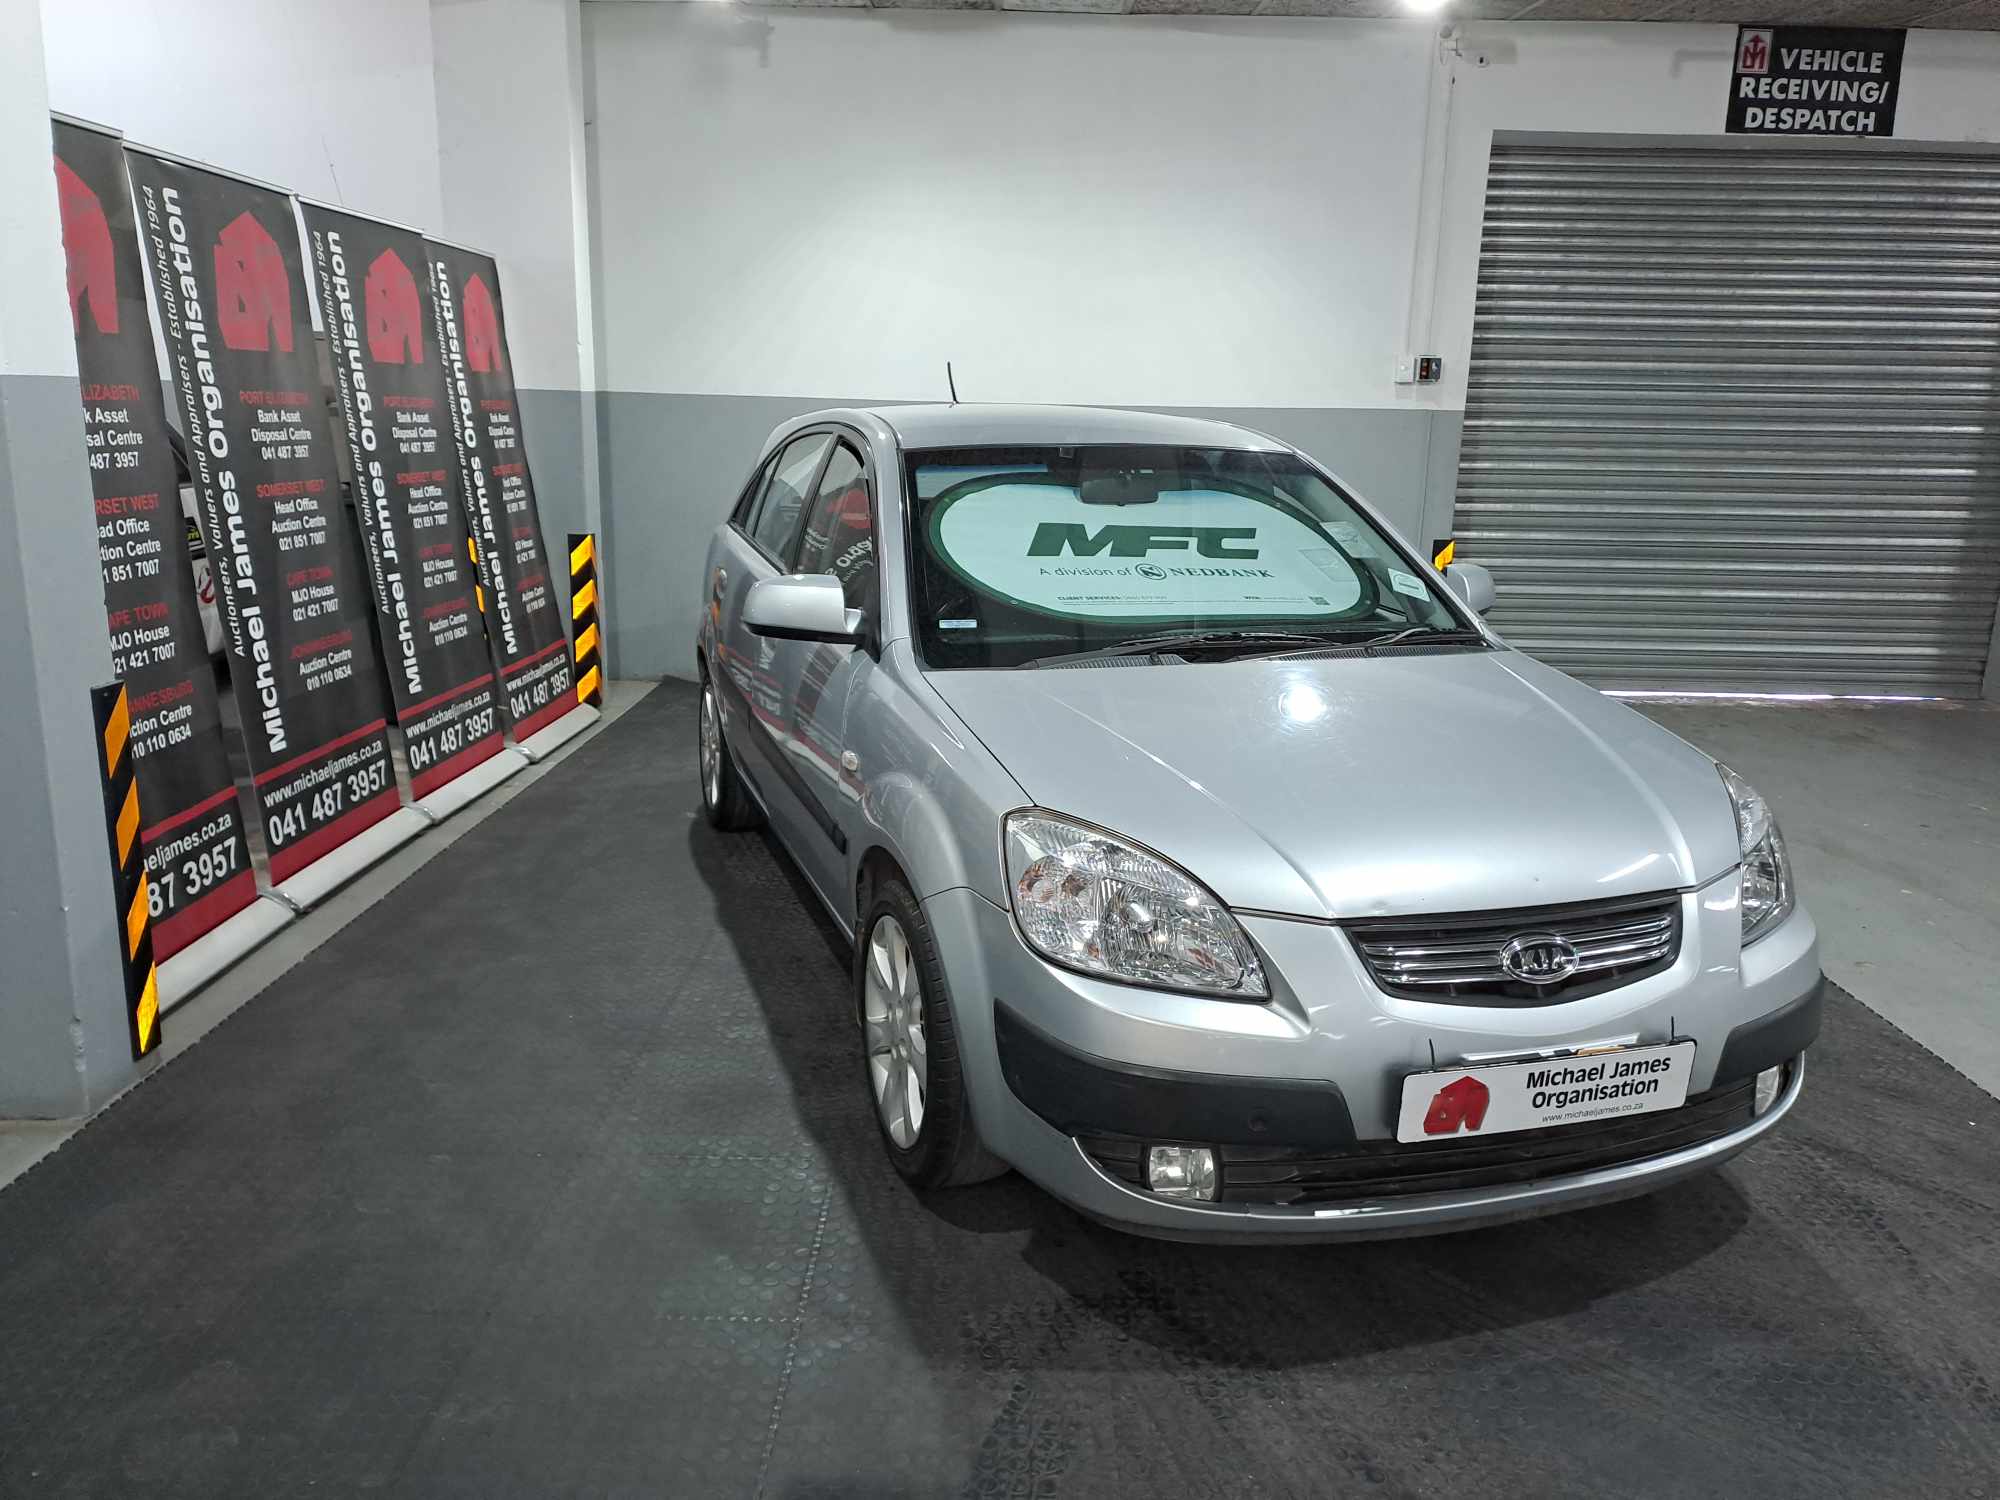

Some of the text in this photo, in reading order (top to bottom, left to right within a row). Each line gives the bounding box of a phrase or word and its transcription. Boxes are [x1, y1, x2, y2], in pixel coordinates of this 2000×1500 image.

[1780, 48, 1884, 73] VEHICLE
[1739, 77, 1890, 104] RECEIVING/
[1744, 107, 1876, 132] DESPATCH
[142, 184, 162, 231] 1964
[152, 233, 183, 339] Established
[82, 384, 139, 401] LIZABETH
[178, 355, 206, 447] Appraisers
[95, 407, 129, 423] Asset
[257, 409, 279, 423] Bank
[107, 429, 144, 446] Centre
[251, 427, 288, 444] Disposal
[89, 451, 139, 469] 487 3957
[194, 449, 210, 484] and
[261, 446, 276, 460] 041
[350, 443, 363, 472] and
[95, 492, 160, 515] RSET WEST
[274, 498, 318, 515] Head Office
[368, 460, 398, 564] James
[470, 456, 496, 544] James
[97, 518, 150, 538] ad Office
[203, 488, 224, 550] Valuers
[218, 470, 257, 595] James
[271, 518, 301, 535] Auction
[100, 538, 162, 561] tion Centre
[279, 536, 293, 551] 021
[293, 533, 308, 549] 851
[1027, 522, 1260, 560] MFC
[111, 563, 133, 582] 851
[135, 558, 160, 577] 7007
[1039, 566, 1276, 579] A division of NEDBANK
[218, 556, 246, 657] Auctioneers,
[291, 584, 335, 604] MJO House
[487, 551, 518, 654] Michael
[292, 606, 307, 622] 021
[307, 603, 321, 617] 421
[134, 625, 170, 645] House
[387, 572, 422, 694] Michael
[113, 641, 176, 674] 21 421 7007
[300, 648, 352, 675] Auction Centre
[242, 606, 287, 753] Michael
[510, 667, 570, 719] 041 487 3957
[160, 704, 193, 725] Centre
[132, 722, 192, 760] 10 110 0634
[409, 707, 493, 770] 041 487 3957
[263, 740, 382, 808] www.michaeljames.co.za
[269, 759, 386, 846] 041 487 3957
[147, 836, 237, 918] 87 3957
[1526, 1056, 1672, 1089] Michael James
[1532, 1078, 1659, 1109] Organisation
[1541, 1102, 1644, 1123] www.michaeljames.co.za
